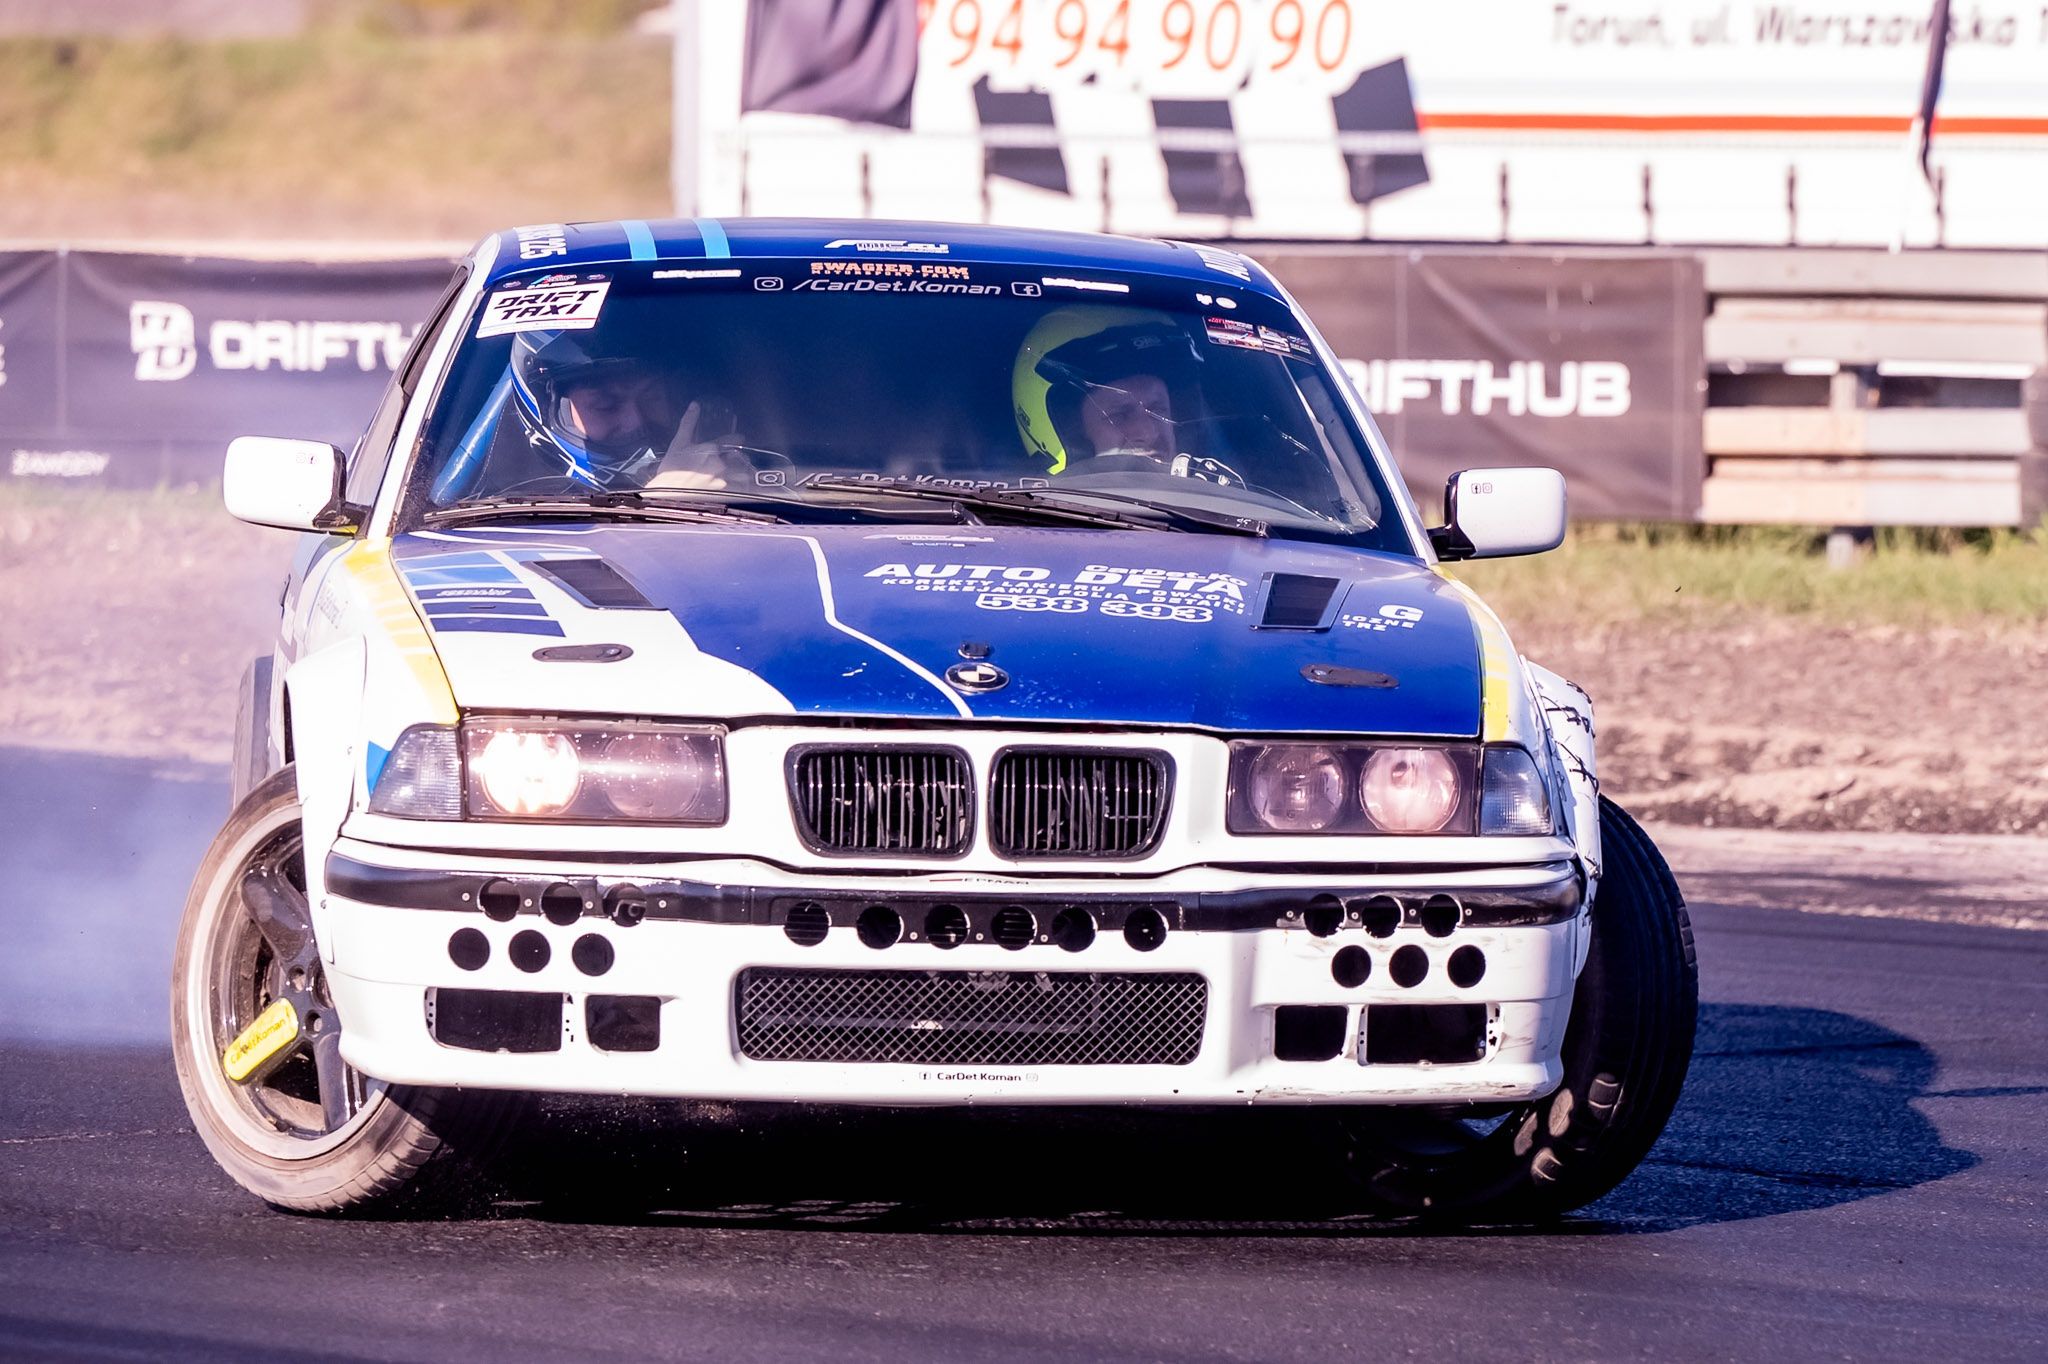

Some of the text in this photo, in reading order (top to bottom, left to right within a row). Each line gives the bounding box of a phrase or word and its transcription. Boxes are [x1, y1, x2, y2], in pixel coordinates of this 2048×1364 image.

[1055, 0, 1129, 67] 94
[1161, 0, 1241, 71] 90
[1270, 0, 1352, 71] 90
[493, 290, 600, 310] DRIFT
[500, 303, 583, 321] TAXI
[882, 578, 994, 586] KOREKTY
[914, 585, 1050, 594] OKLEJANIE
[863, 563, 1424, 622] AUTO DETA G
